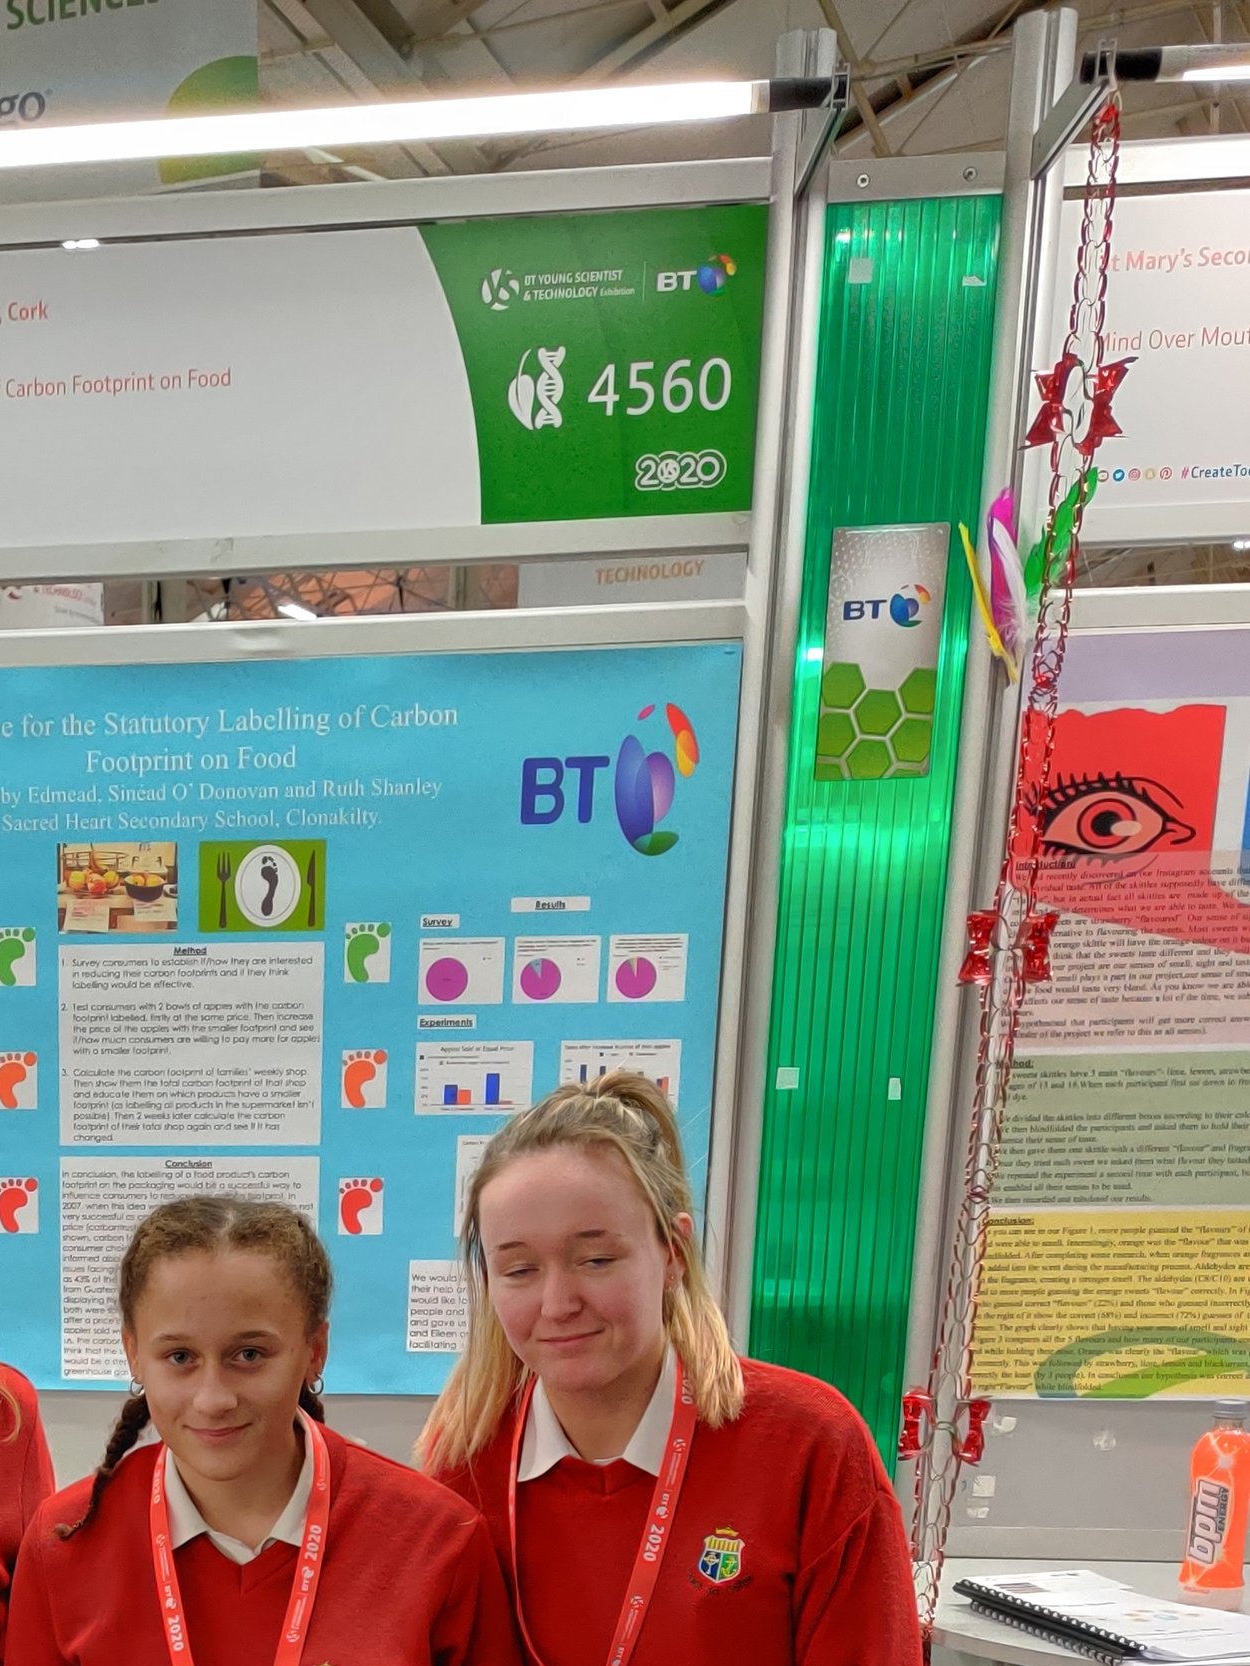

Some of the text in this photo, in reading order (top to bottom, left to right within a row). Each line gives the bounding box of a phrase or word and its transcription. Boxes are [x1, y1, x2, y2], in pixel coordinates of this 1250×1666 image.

[7, 0, 162, 31] SCIE
[1125, 247, 1192, 273] Mary's
[524, 268, 623, 287] BT YOUNG SCIENTIST
[656, 269, 698, 293] BT
[523, 285, 636, 302] & TECHNOLOGY Exhibition
[7, 300, 47, 321] Cork
[1148, 329, 1195, 350] Over
[5, 377, 66, 398] Carbon
[72, 371, 154, 396] Footprint
[160, 375, 181, 390] on
[188, 367, 231, 389] Food
[587, 357, 731, 416] 4560
[596, 559, 705, 585] TECHNOLOGY
[843, 599, 887, 621] BT
[20, 713, 54, 737] for
[60, 713, 96, 737] the
[104, 712, 210, 739] Statutory
[218, 706, 330, 736] Labelling
[338, 704, 366, 729] of
[373, 702, 458, 728] Carbon
[86, 744, 296, 778] Footprint on Food
[28, 784, 102, 804] Edmead,
[198, 782, 278, 800] Donovan
[284, 779, 317, 799] and
[322, 778, 364, 798] Ruth
[371, 777, 442, 802] Shanley
[520, 755, 608, 825] BT
[2, 807, 381, 832] Sacred Heart Secondary School, Clonakilty.
[534, 900, 565, 910] Results
[420, 917, 453, 927] Survey
[174, 946, 207, 955] Method
[419, 1017, 473, 1029] Experiments
[164, 1159, 213, 1168] Conclusion
[1188, 1479, 1222, 1564] bpm
[1217, 1486, 1229, 1532] ENERGY
[304, 1524, 322, 1562] 2020
[643, 1524, 665, 1562] 2020
[167, 1614, 184, 1653] 2020
